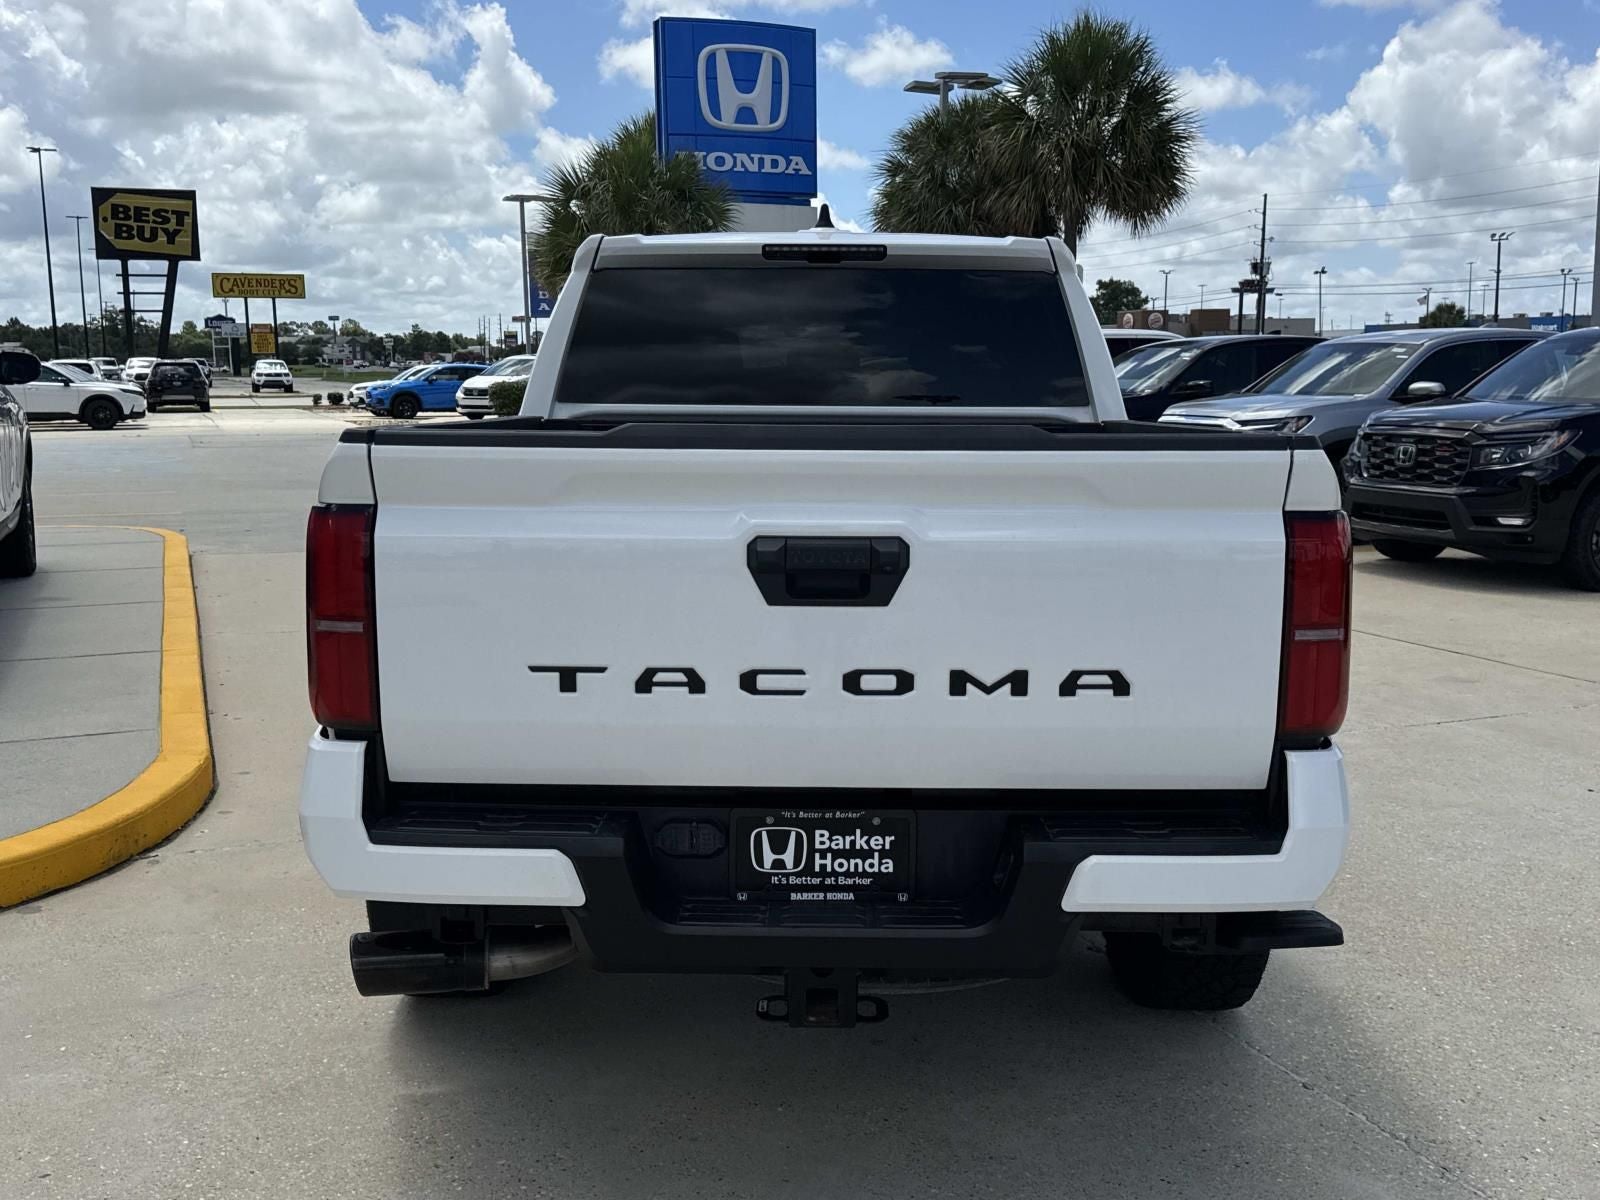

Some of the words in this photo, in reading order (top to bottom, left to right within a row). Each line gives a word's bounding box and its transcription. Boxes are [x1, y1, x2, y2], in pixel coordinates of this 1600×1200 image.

[110, 203, 190, 227] BEST
[114, 222, 183, 245] BUY
[219, 276, 299, 295] CAVENDER'S
[528, 665, 1131, 697] TACOMA
[798, 811, 822, 819] Better
[824, 811, 833, 819] at
[814, 828, 895, 850] Barker
[814, 852, 894, 873] Honda
[771, 875, 787, 885] It's
[789, 875, 822, 885] Better
[824, 876, 836, 885] at
[838, 876, 873, 885] Barker
[790, 892, 825, 901] BARKER
[826, 892, 855, 901] HONDA
